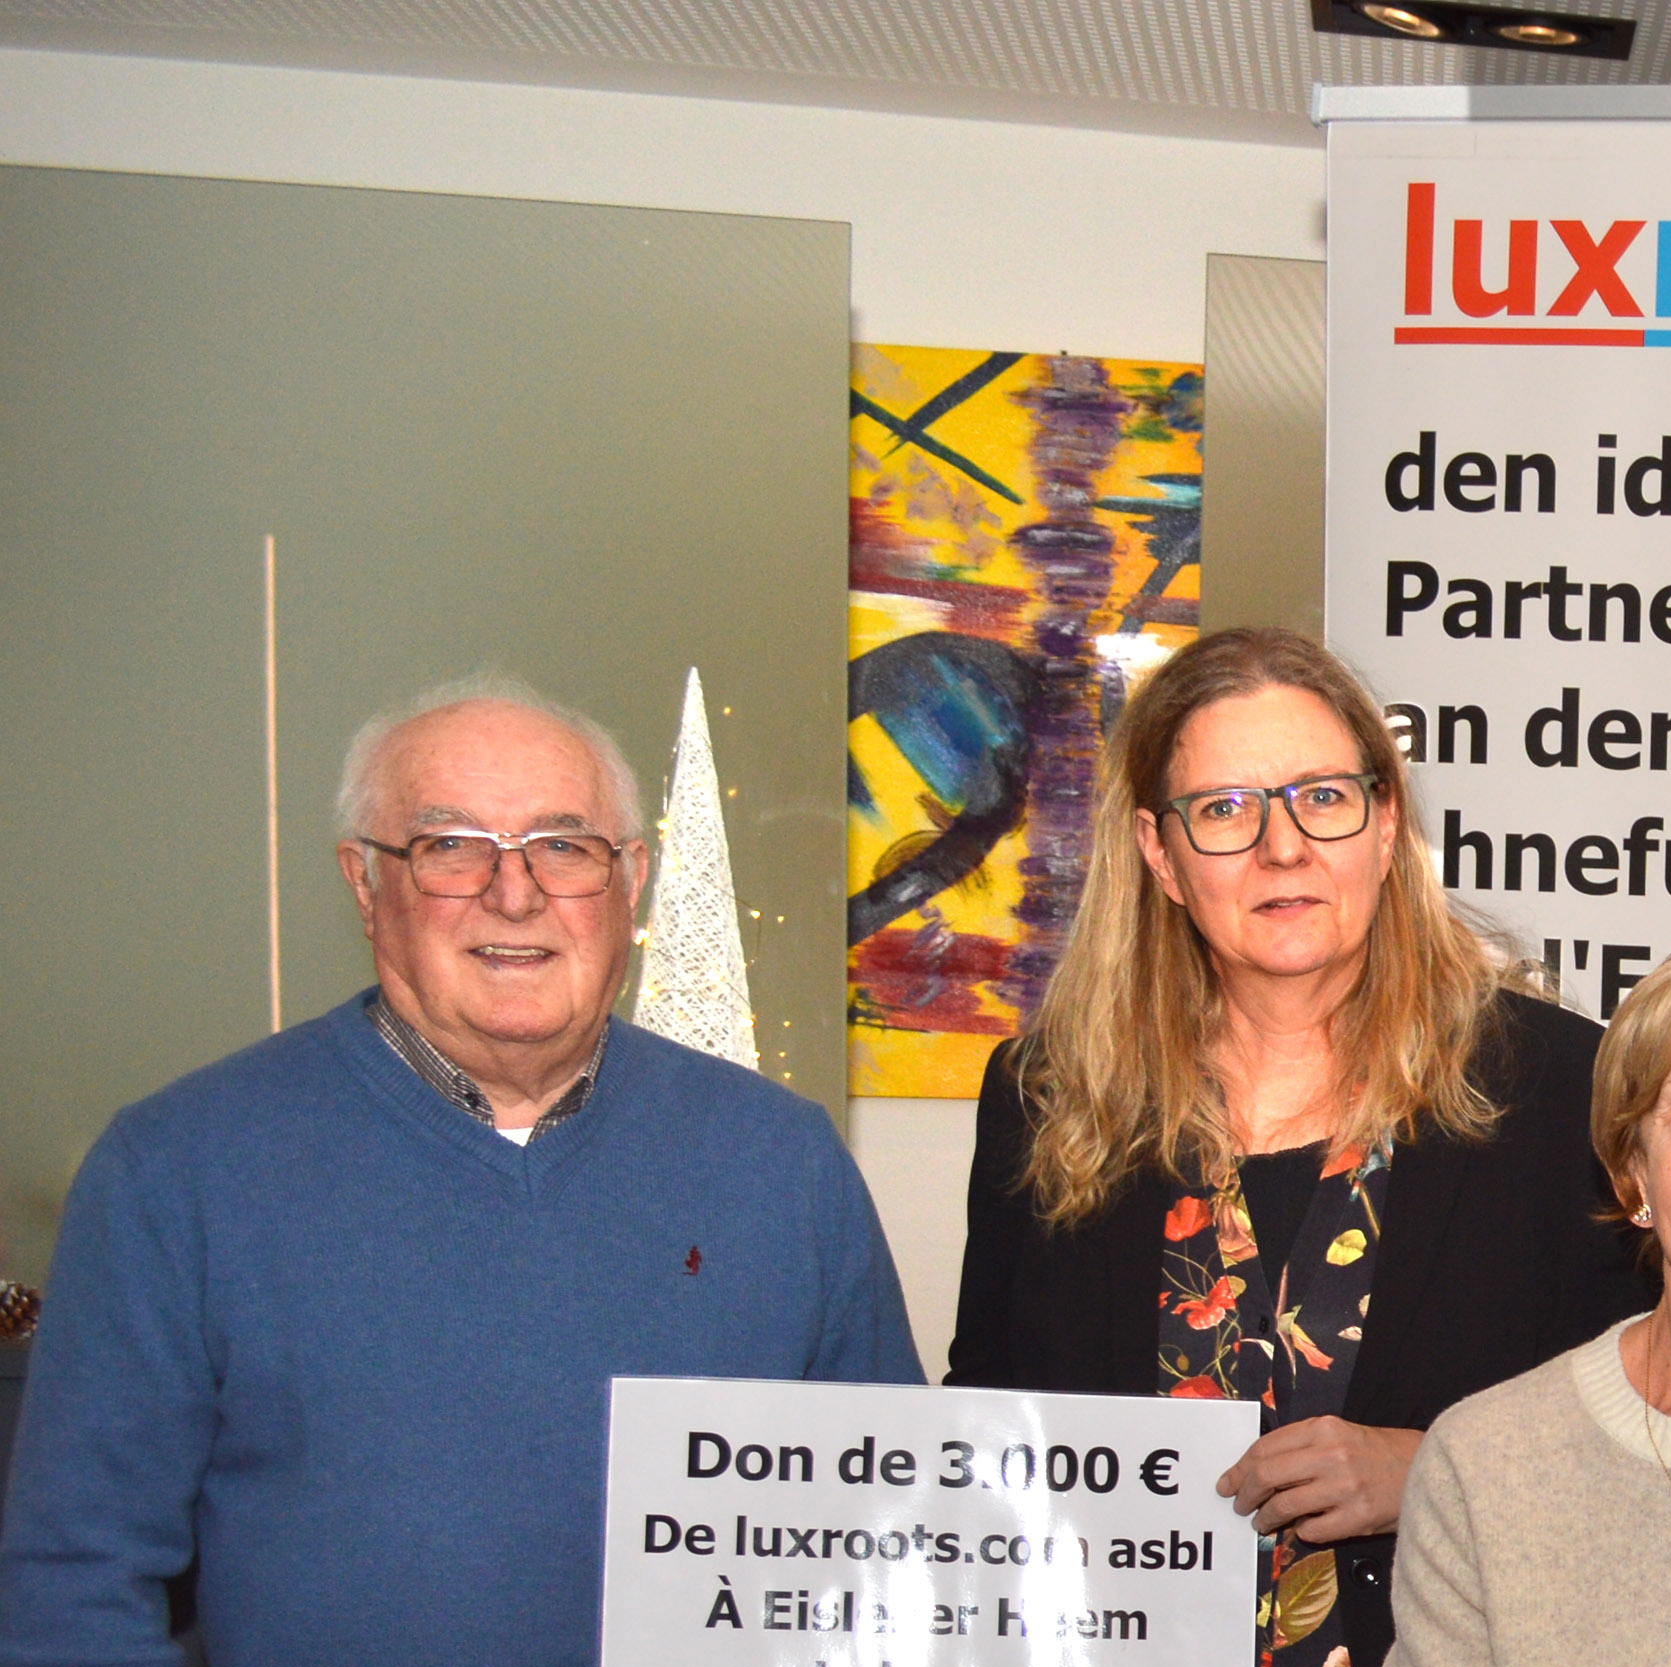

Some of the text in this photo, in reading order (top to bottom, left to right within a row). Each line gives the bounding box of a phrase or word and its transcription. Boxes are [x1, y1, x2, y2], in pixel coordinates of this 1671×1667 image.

[1384, 430, 1556, 514] den
[1384, 703, 1488, 765] an
[688, 1431, 1180, 1496] Don de 3.000 €
[645, 1514, 716, 1556] De
[1108, 1531, 1213, 1571] asbl
[705, 1575, 1148, 1641] À Eisler Hem
